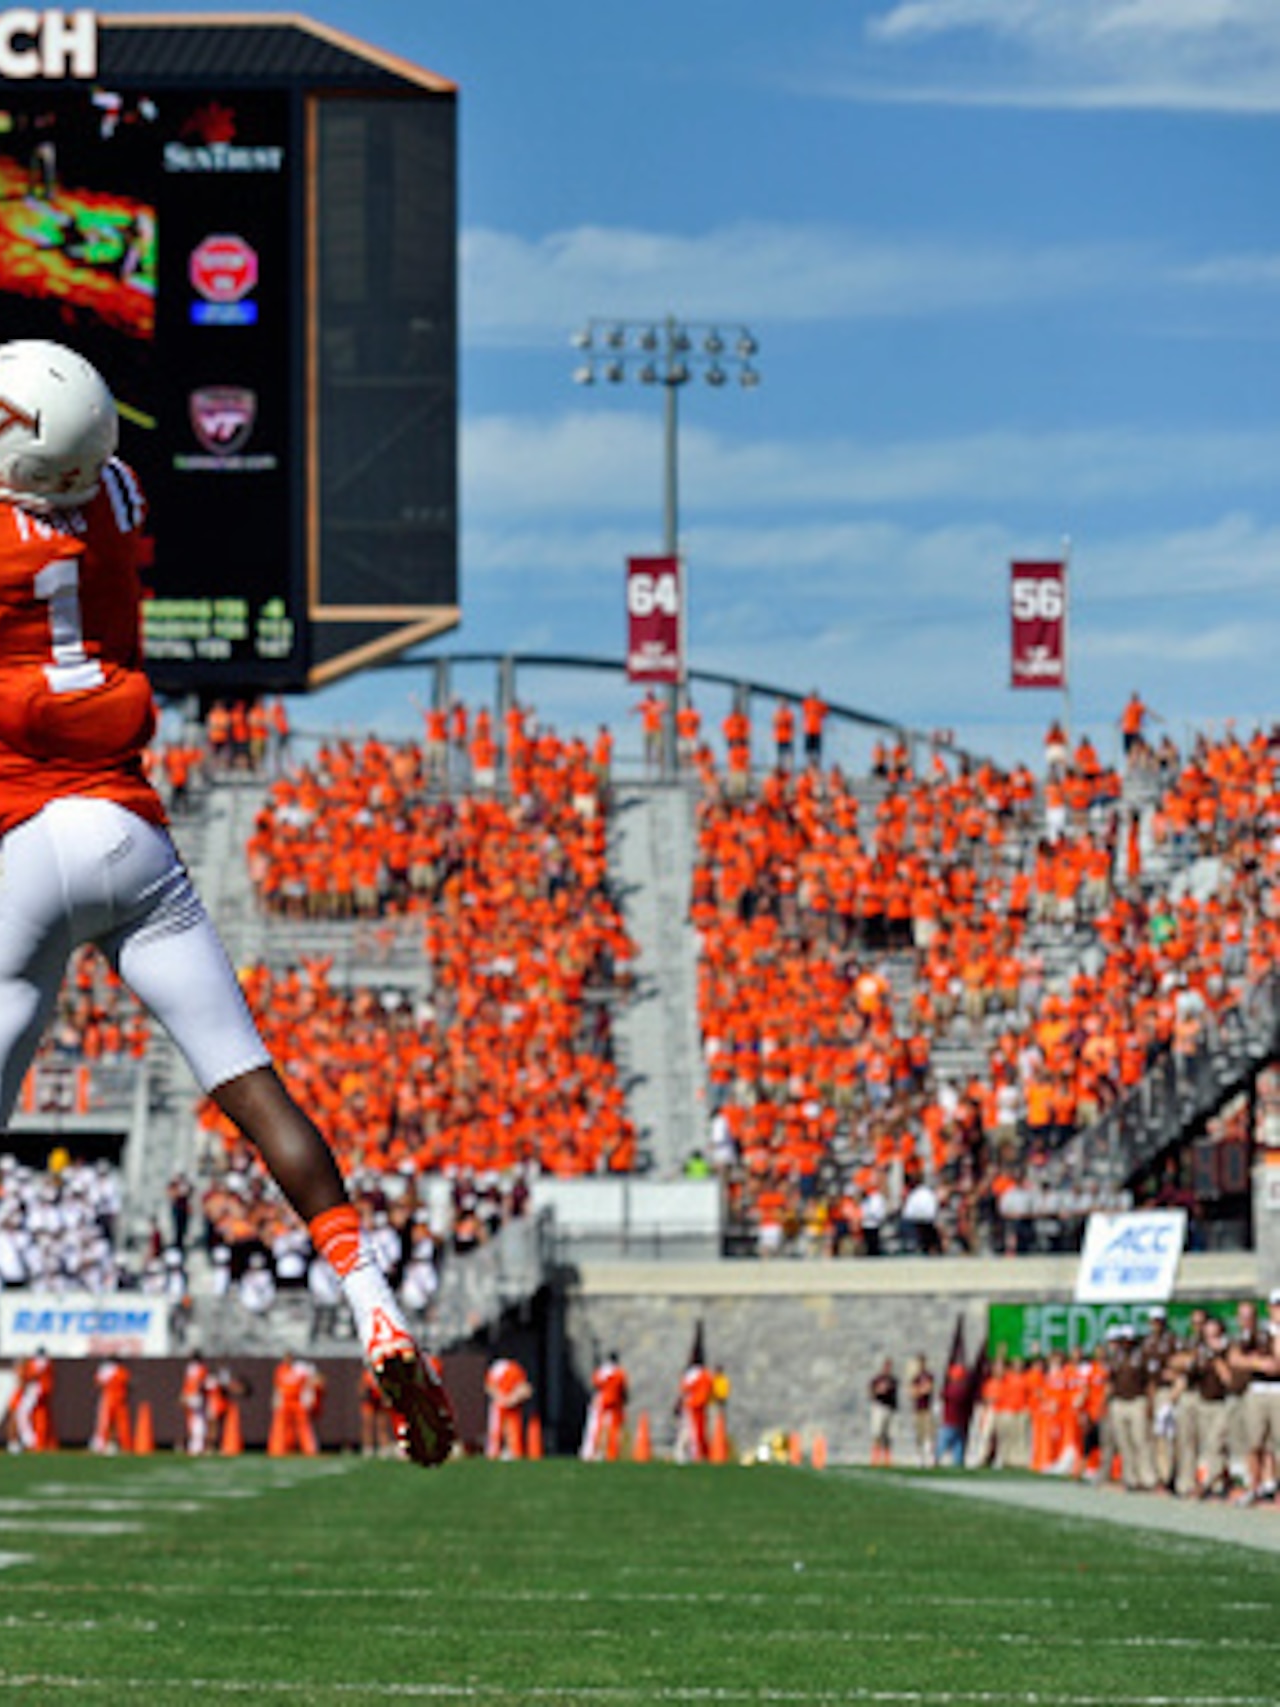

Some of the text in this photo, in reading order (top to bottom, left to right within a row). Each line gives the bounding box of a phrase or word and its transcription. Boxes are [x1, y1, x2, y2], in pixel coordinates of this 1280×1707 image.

[628, 572, 677, 616] 64
[1012, 577, 1063, 621] 56
[33, 559, 106, 693] 1
[1104, 1224, 1174, 1254] ACC
